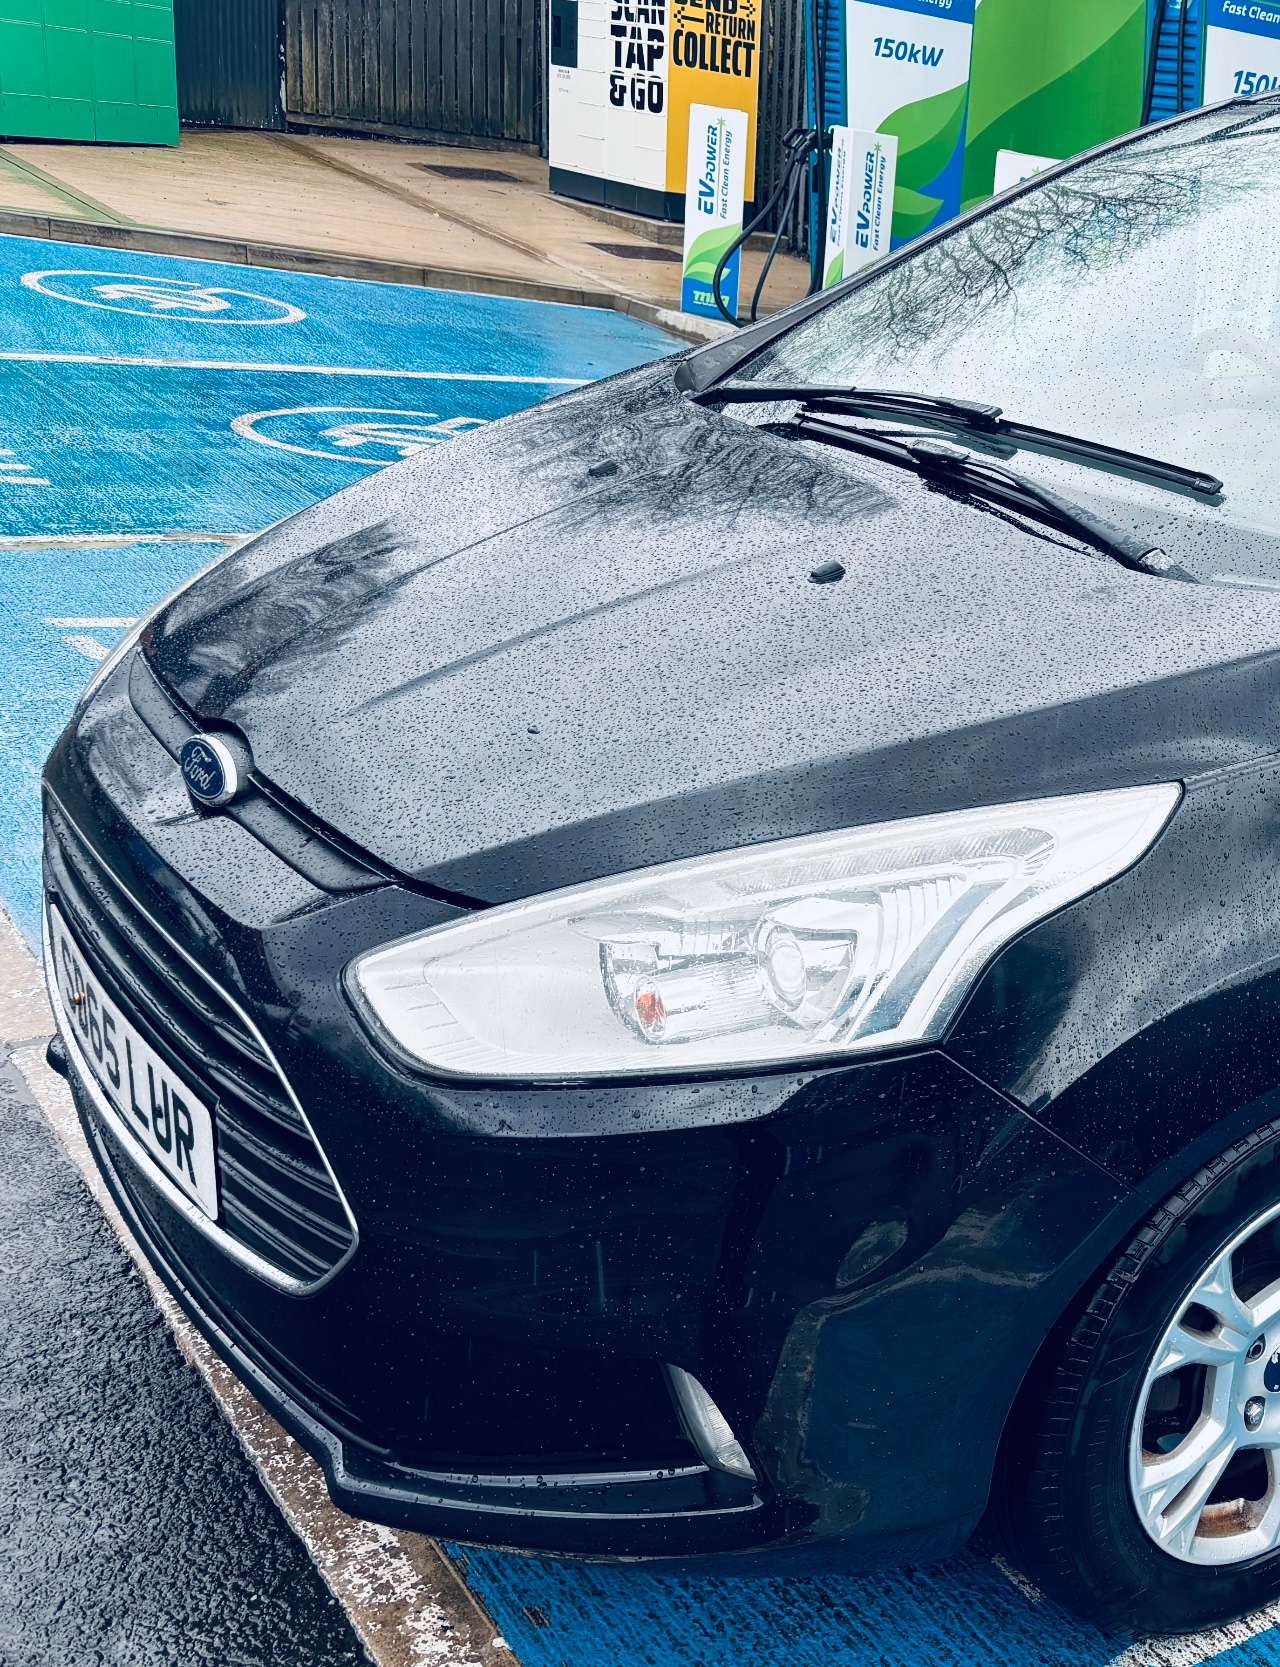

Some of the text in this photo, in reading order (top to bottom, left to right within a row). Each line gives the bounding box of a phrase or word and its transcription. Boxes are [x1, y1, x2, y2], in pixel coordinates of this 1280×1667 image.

[705, 12, 756, 41] RETURN
[1222, 1, 1247, 16] Fast
[1249, 6, 1280, 23] Clean
[610, 24, 665, 72] TAP
[673, 29, 756, 78] COLLECT
[873, 36, 944, 67] 150kW
[609, 70, 664, 114] & GO
[719, 130, 733, 220] Fast Clean Energy
[872, 156, 887, 252] Fast Clean Energy
[184, 746, 216, 790] Ford
[125, 1034, 198, 1190] LUR
